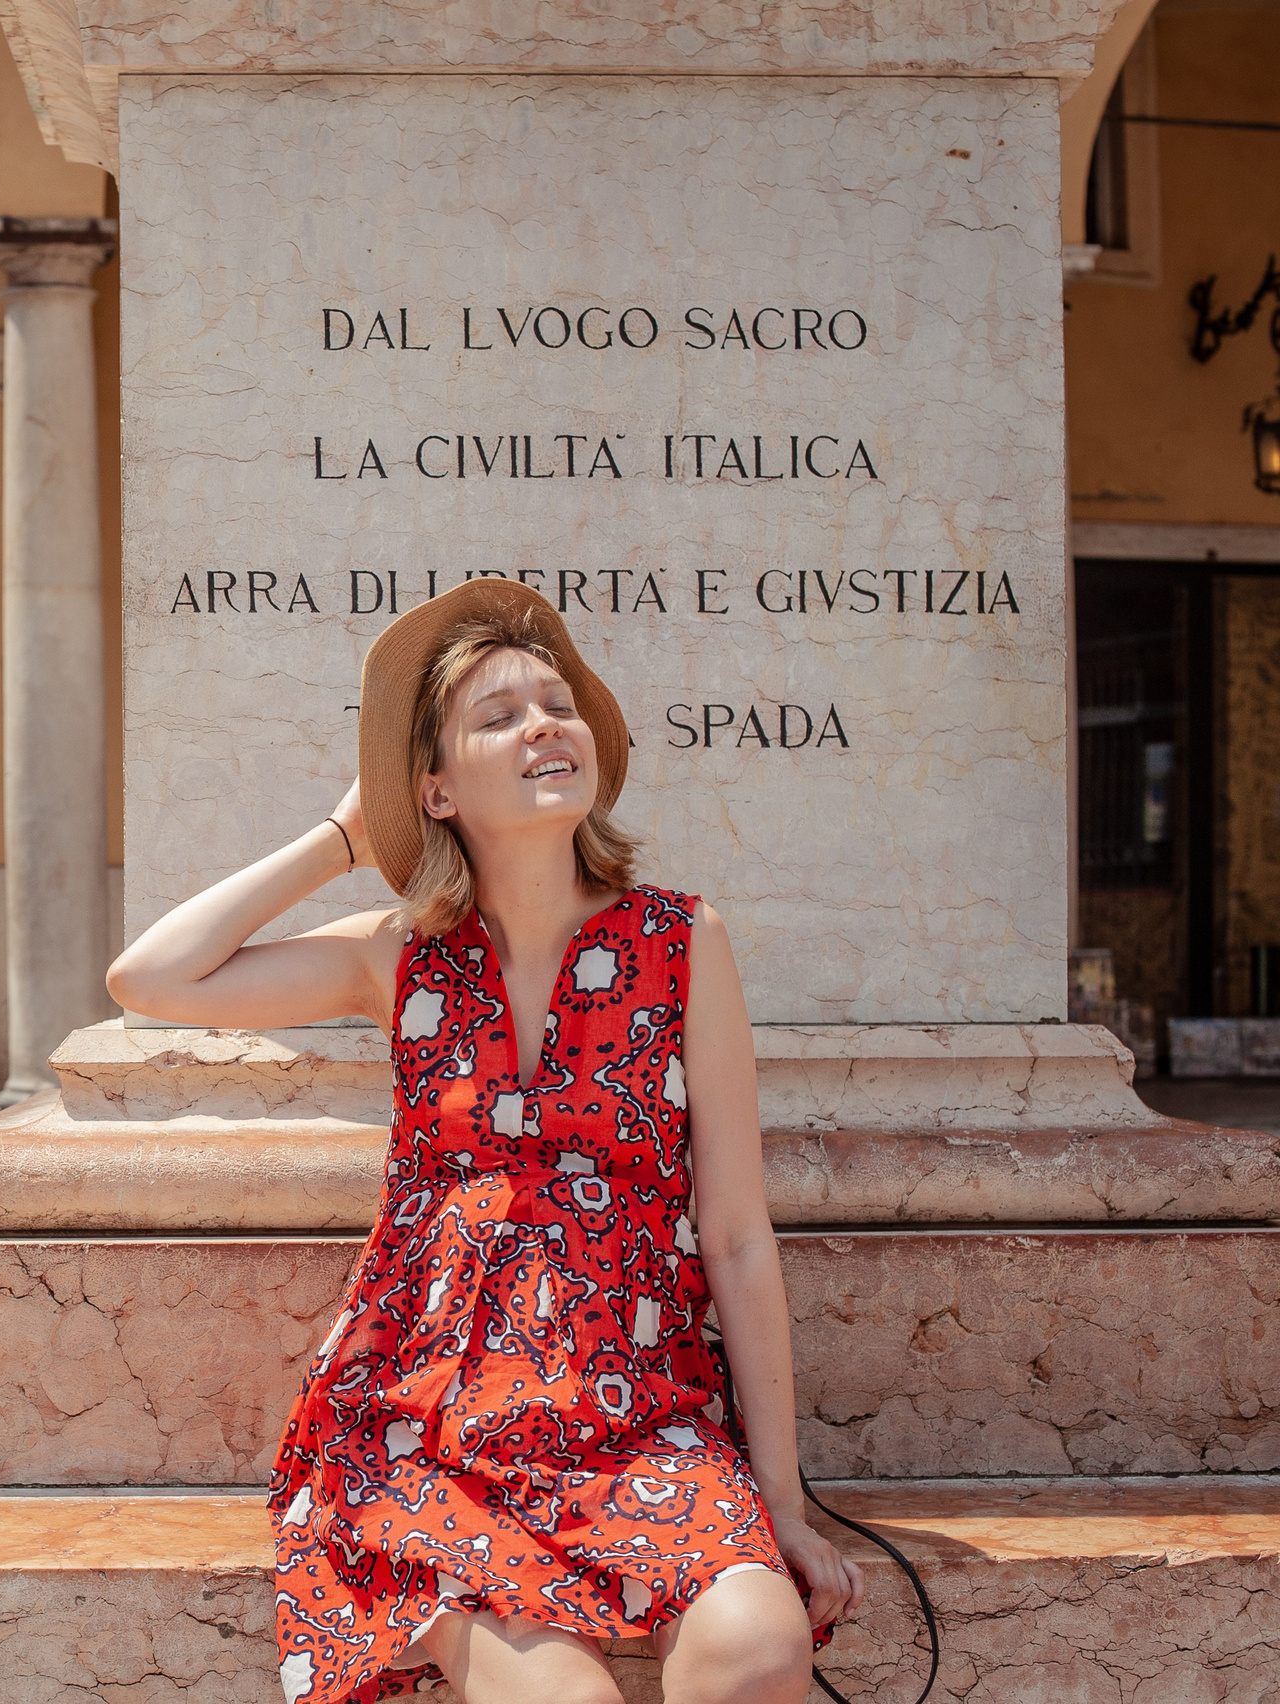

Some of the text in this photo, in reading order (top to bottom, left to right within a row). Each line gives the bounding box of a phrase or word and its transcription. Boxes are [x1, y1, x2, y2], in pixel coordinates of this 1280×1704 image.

[322, 306, 867, 351] DAL LVOGO SACRO
[313, 436, 389, 480] LA
[664, 434, 879, 480] ITALICA
[170, 570, 321, 614] ARRA
[349, 570, 400, 615] DI
[696, 569, 730, 615] E
[755, 569, 1021, 616] GIVSTIZIA
[666, 702, 850, 751] SPADA
